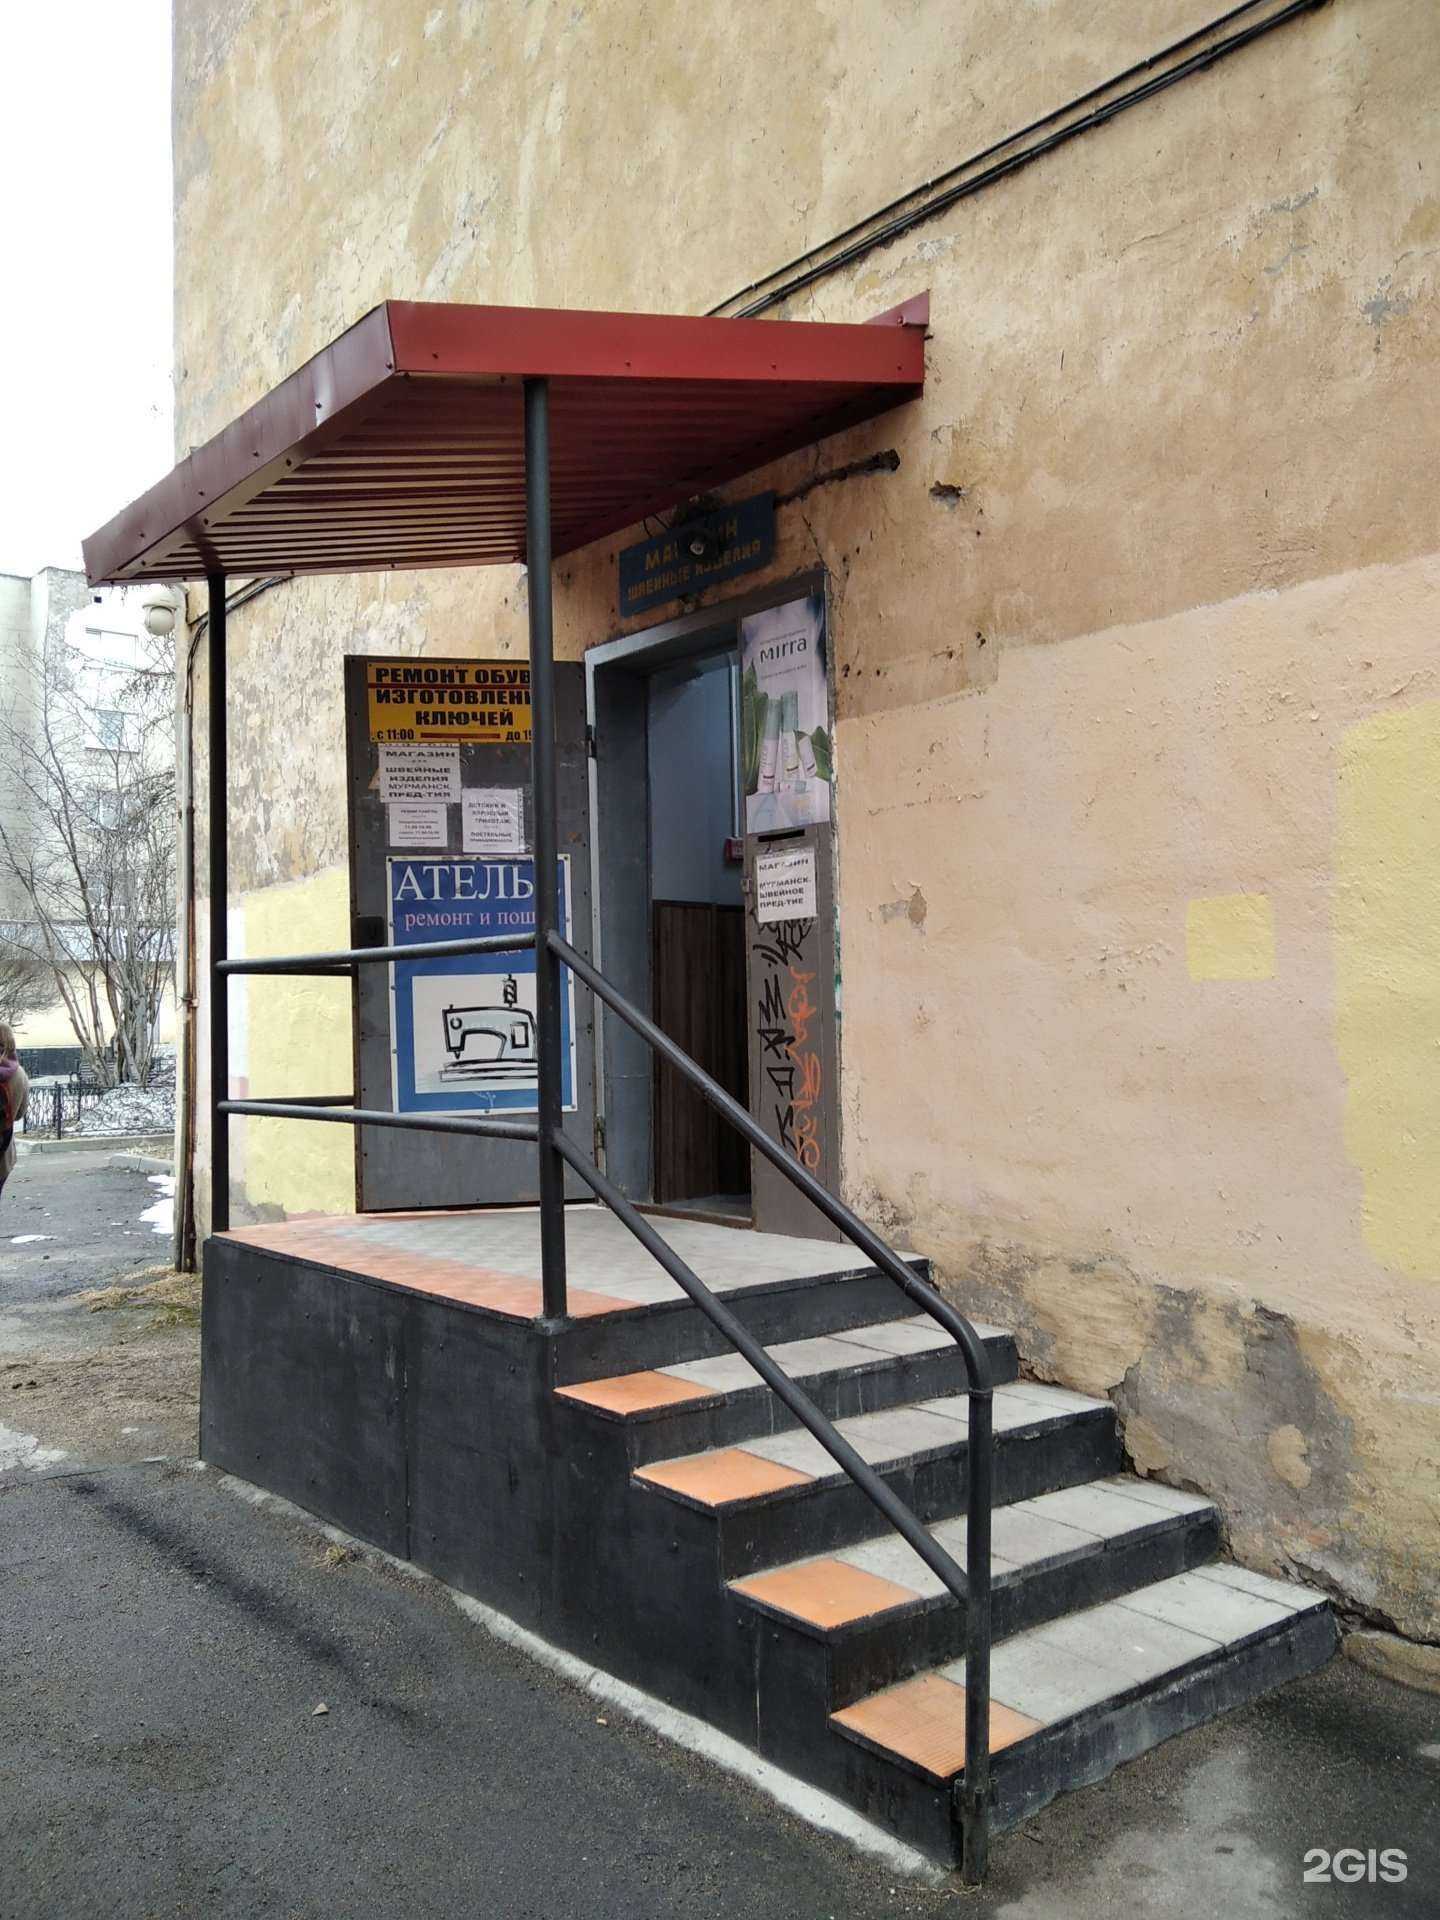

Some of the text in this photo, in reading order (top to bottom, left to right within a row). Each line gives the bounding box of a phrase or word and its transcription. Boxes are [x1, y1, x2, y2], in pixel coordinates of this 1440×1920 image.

[375, 668, 531, 684] РЕМОНТ ОБУВ
[376, 689, 531, 705] ИЗГОТОВЛЕН
[415, 708, 514, 726] КЛЮЧЕЙ
[387, 728, 415, 740] 11:00
[506, 731, 521, 742] до
[522, 728, 532, 740] 1
[389, 775, 449, 783] ИЗДЕЛИЯ
[393, 864, 560, 900] АТЕЛЬ
[405, 911, 537, 932] ремонт и пош
